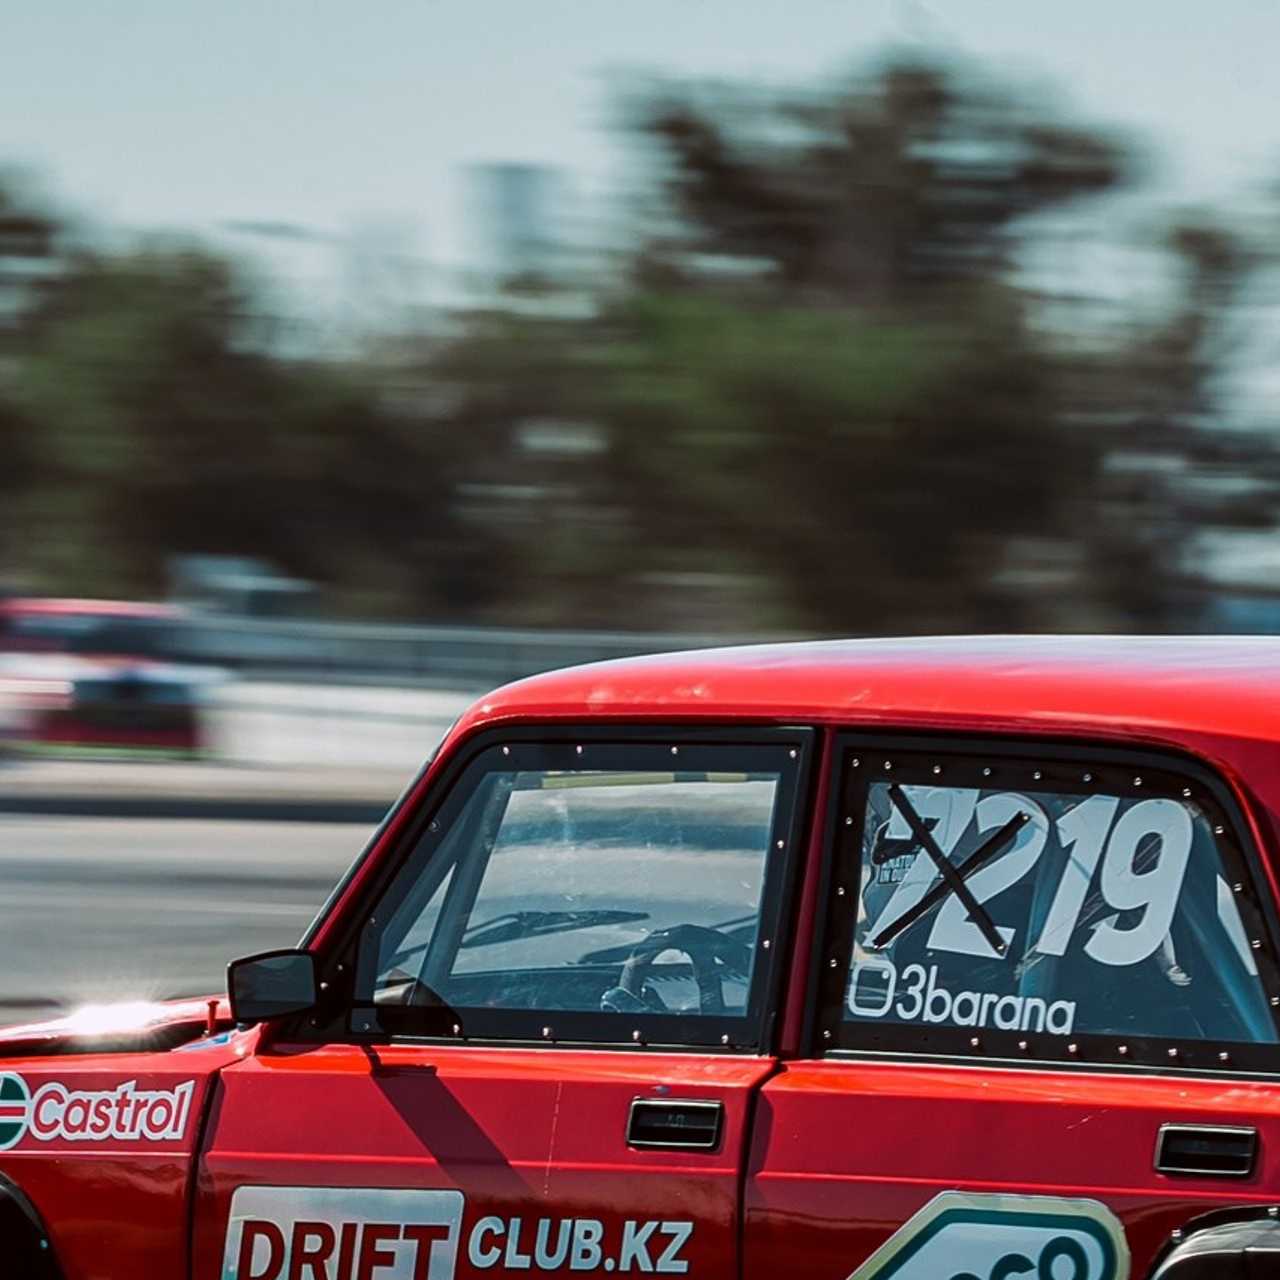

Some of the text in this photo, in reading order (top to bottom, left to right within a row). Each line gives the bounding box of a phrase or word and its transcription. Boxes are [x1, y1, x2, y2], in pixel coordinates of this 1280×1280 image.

[863, 784, 1194, 966] 7219
[896, 963, 1077, 1036] 3barana
[32, 1083, 192, 1138] Castrol
[468, 1216, 694, 1273] CLUB.KZ
